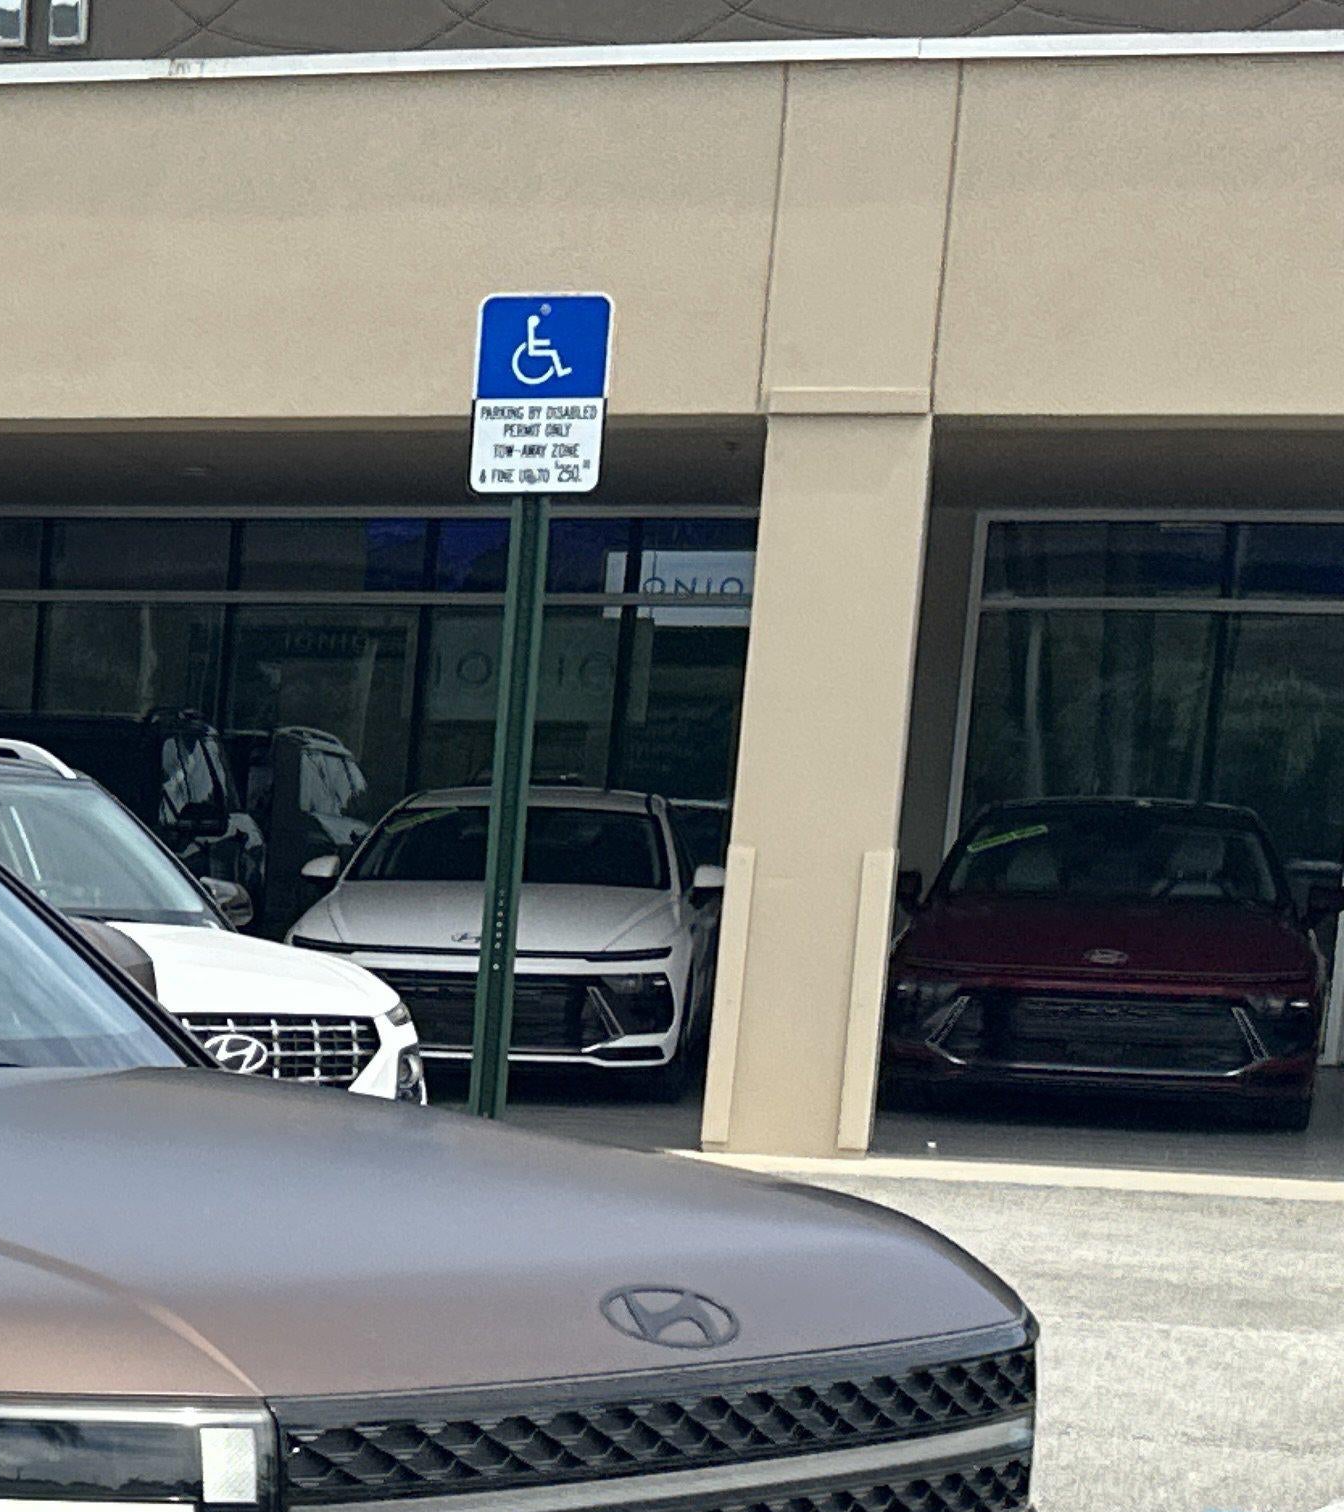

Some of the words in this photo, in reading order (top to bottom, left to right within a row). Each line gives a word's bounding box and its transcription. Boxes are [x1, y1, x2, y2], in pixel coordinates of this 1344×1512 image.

[480, 405, 524, 420] PARKING
[528, 405, 542, 420] BY
[546, 404, 598, 420] DISABLED
[503, 423, 541, 438] PERMIT
[544, 423, 572, 438] ONLY
[551, 442, 580, 458] ZONE
[491, 468, 515, 483] FINE
